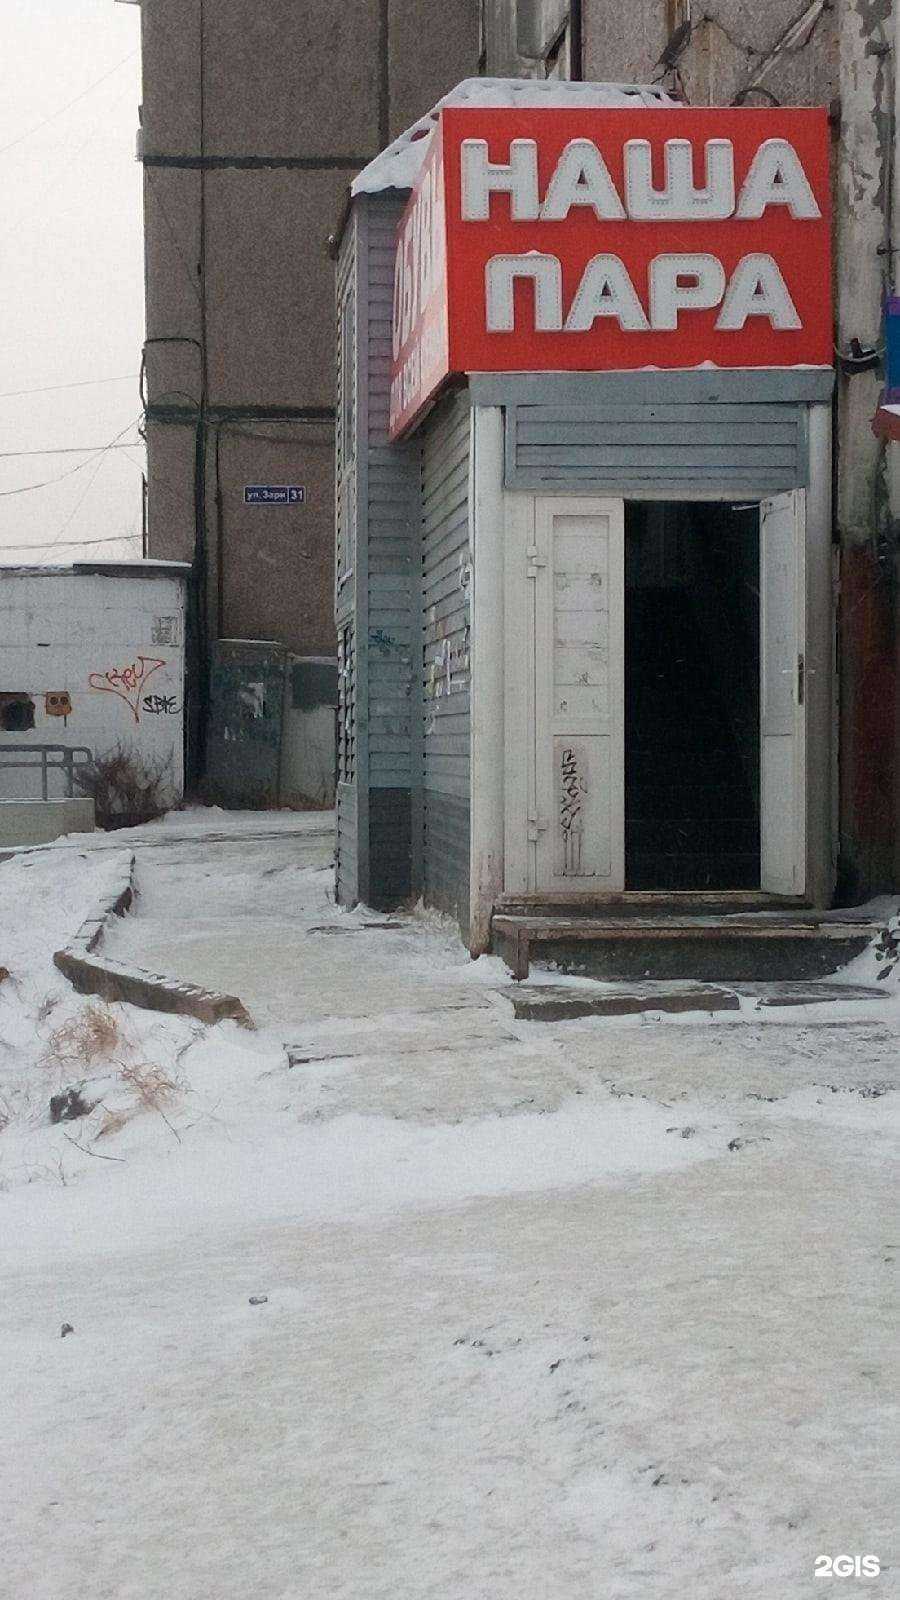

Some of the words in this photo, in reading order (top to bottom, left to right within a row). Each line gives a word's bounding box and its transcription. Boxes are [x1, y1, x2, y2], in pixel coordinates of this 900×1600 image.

[460, 138, 822, 222] НАША
[392, 154, 447, 362] ОБУВЬ
[484, 250, 803, 333] ПАРА
[290, 489, 303, 500] 31
